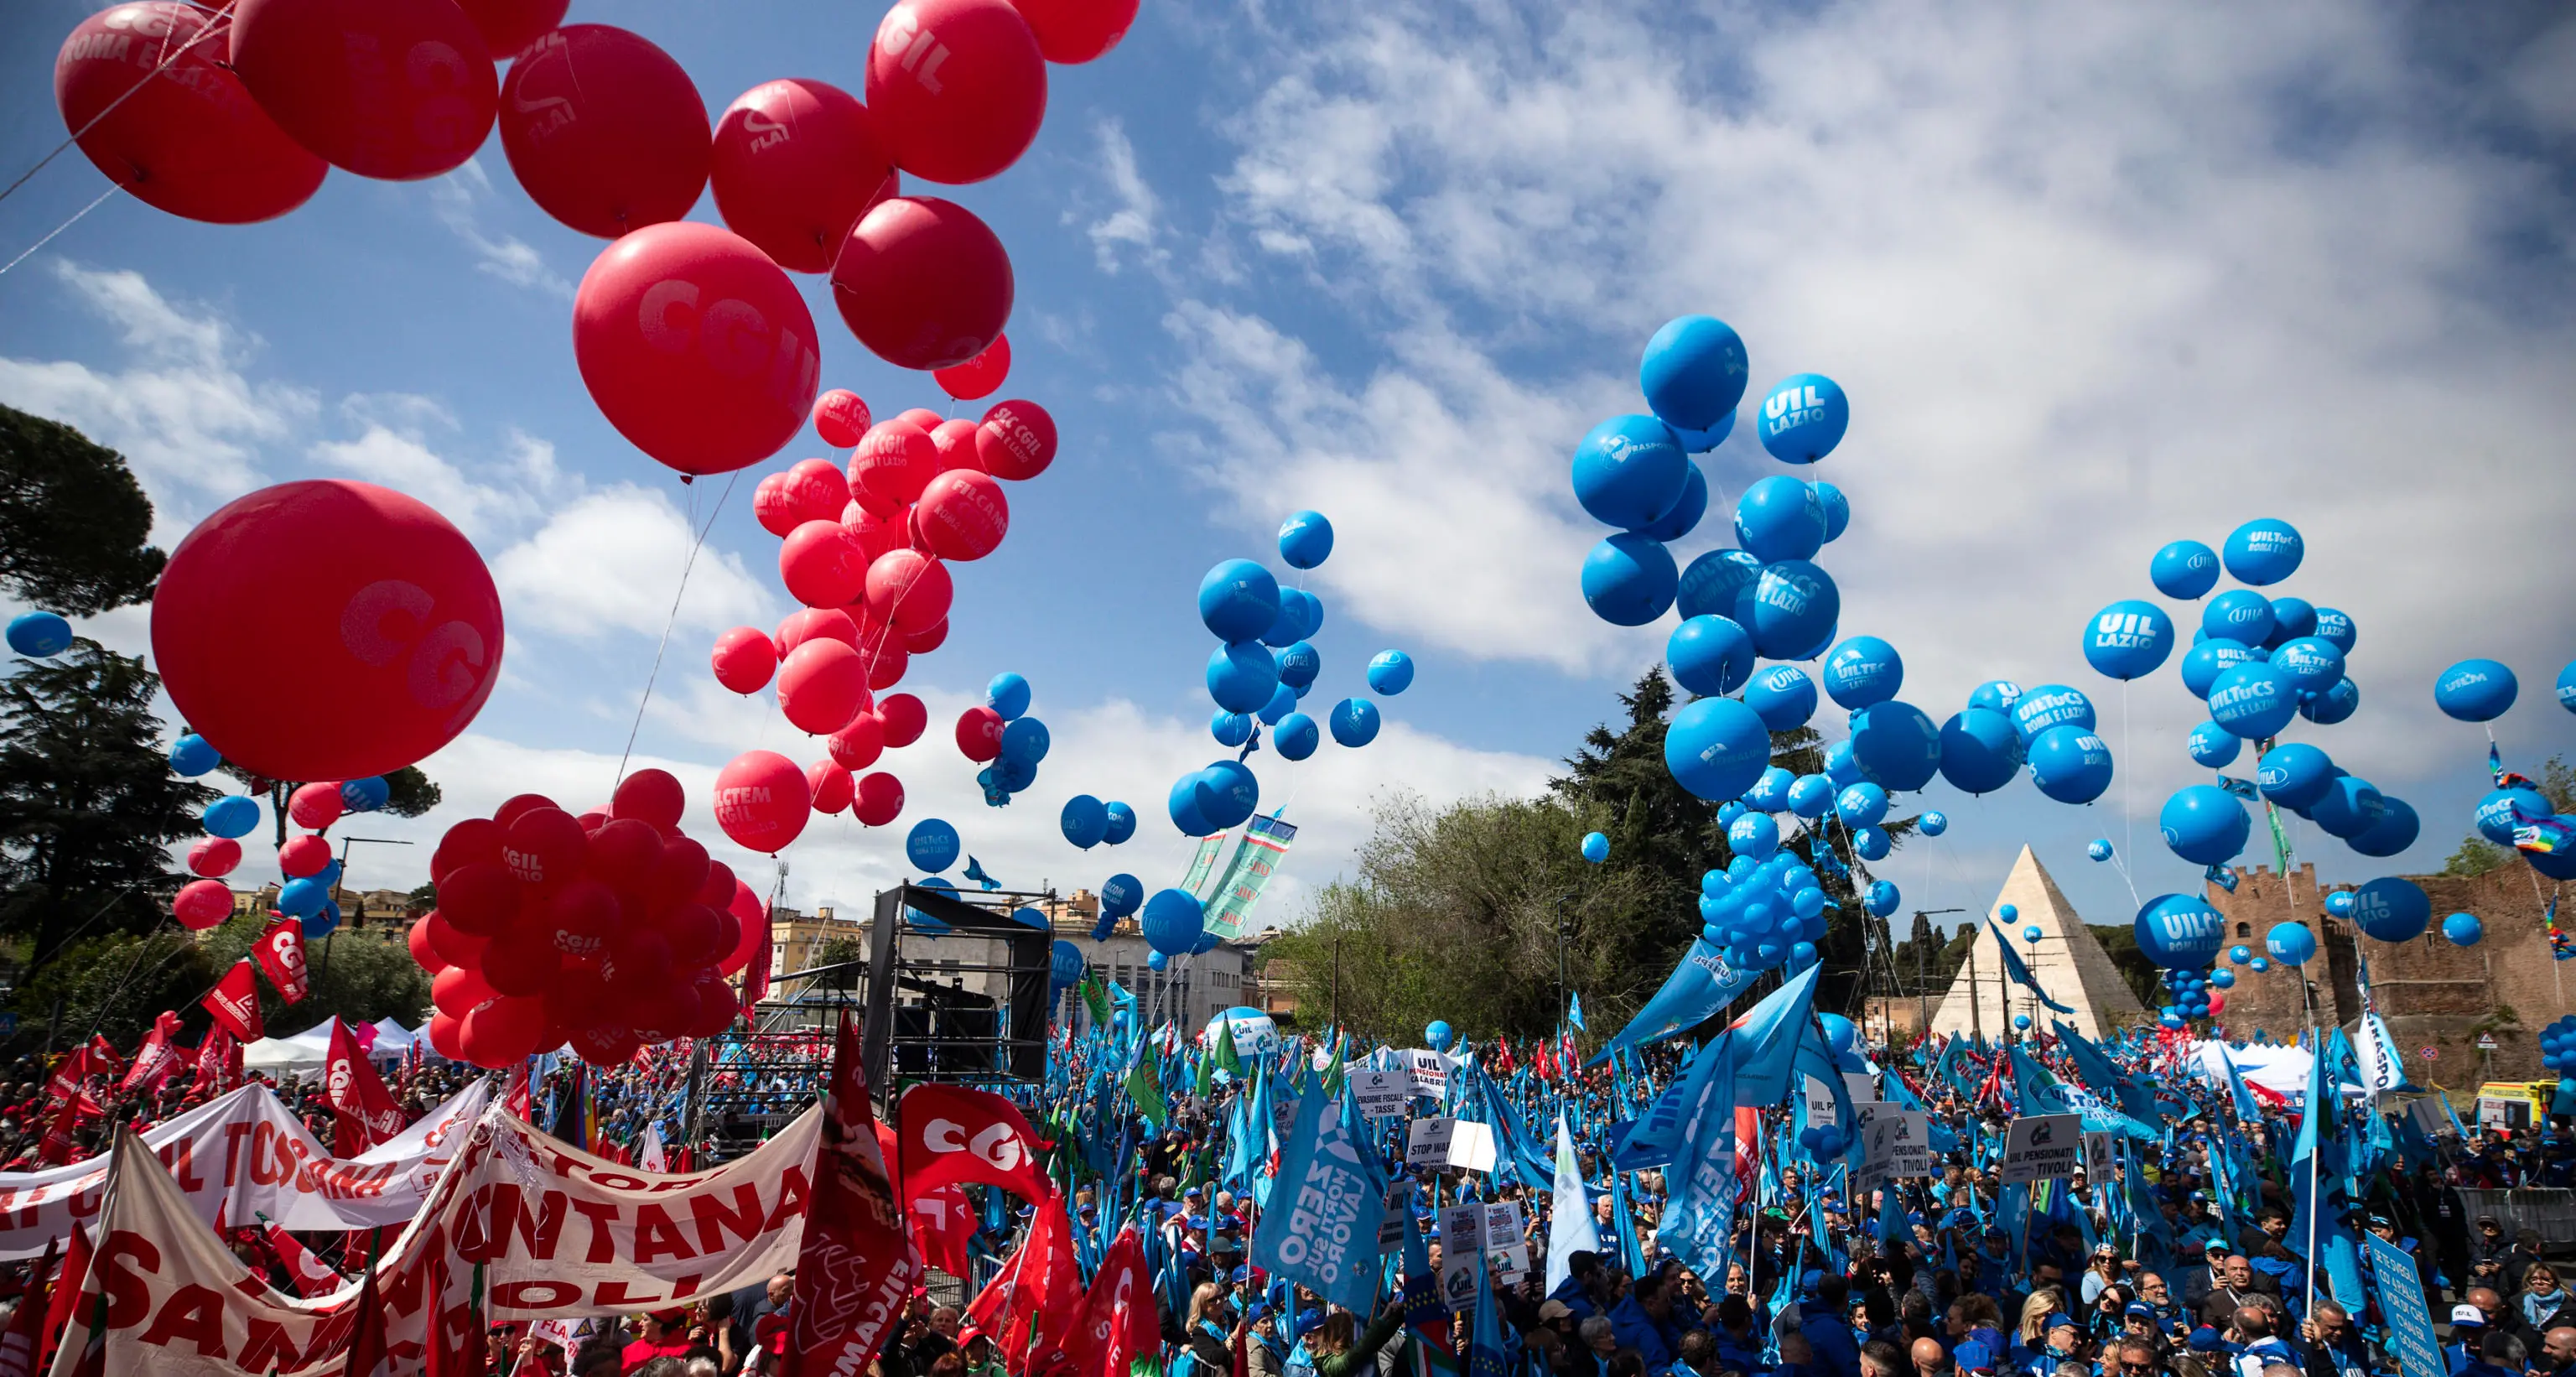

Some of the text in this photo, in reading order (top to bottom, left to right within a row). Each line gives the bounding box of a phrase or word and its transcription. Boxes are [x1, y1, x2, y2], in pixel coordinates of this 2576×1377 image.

[828, 393, 850, 413] SPI
[1766, 385, 1825, 419] UIL
[1768, 408, 1826, 436] LAZIO
[878, 434, 906, 455] CGIL
[1014, 423, 1041, 457] CGIL
[952, 479, 1007, 536] FILCAMS
[2099, 614, 2157, 637] UIL
[2096, 634, 2153, 650] LAZIO
[2210, 681, 2275, 709] UILTuCS
[2018, 692, 2084, 722] UILTuCS
[2024, 712, 2054, 735] ROMA
[2054, 709, 2061, 721] E
[982, 720, 1005, 743] CG
[719, 808, 756, 825] CGIL
[1732, 820, 1756, 831] UIL
[1731, 829, 1756, 842] FPL
[556, 929, 601, 948] CGIL
[1239, 1026, 1253, 1035] UIL
[1263, 1039, 1273, 1047] UIL
[1417, 1057, 1441, 1071] UIL
[1409, 1068, 1448, 1078] PENSIONAT
[1357, 1093, 1404, 1104] EVASIONE FISCALE
[1811, 1100, 1826, 1111] UIL
[1375, 1104, 1396, 1114] TASSE
[1410, 1144, 1431, 1156] STOP
[1892, 1145, 1927, 1156] PENSIONATI
[2008, 1147, 2074, 1163] UIL PENSIONATI
[225, 1119, 399, 1200] TOSCANA
[1903, 1159, 1928, 1172] TIVOLI
[2037, 1161, 2072, 1176] TIVOLI
[1496, 1260, 1514, 1272] UIL
[1457, 1279, 1474, 1291] UIL
